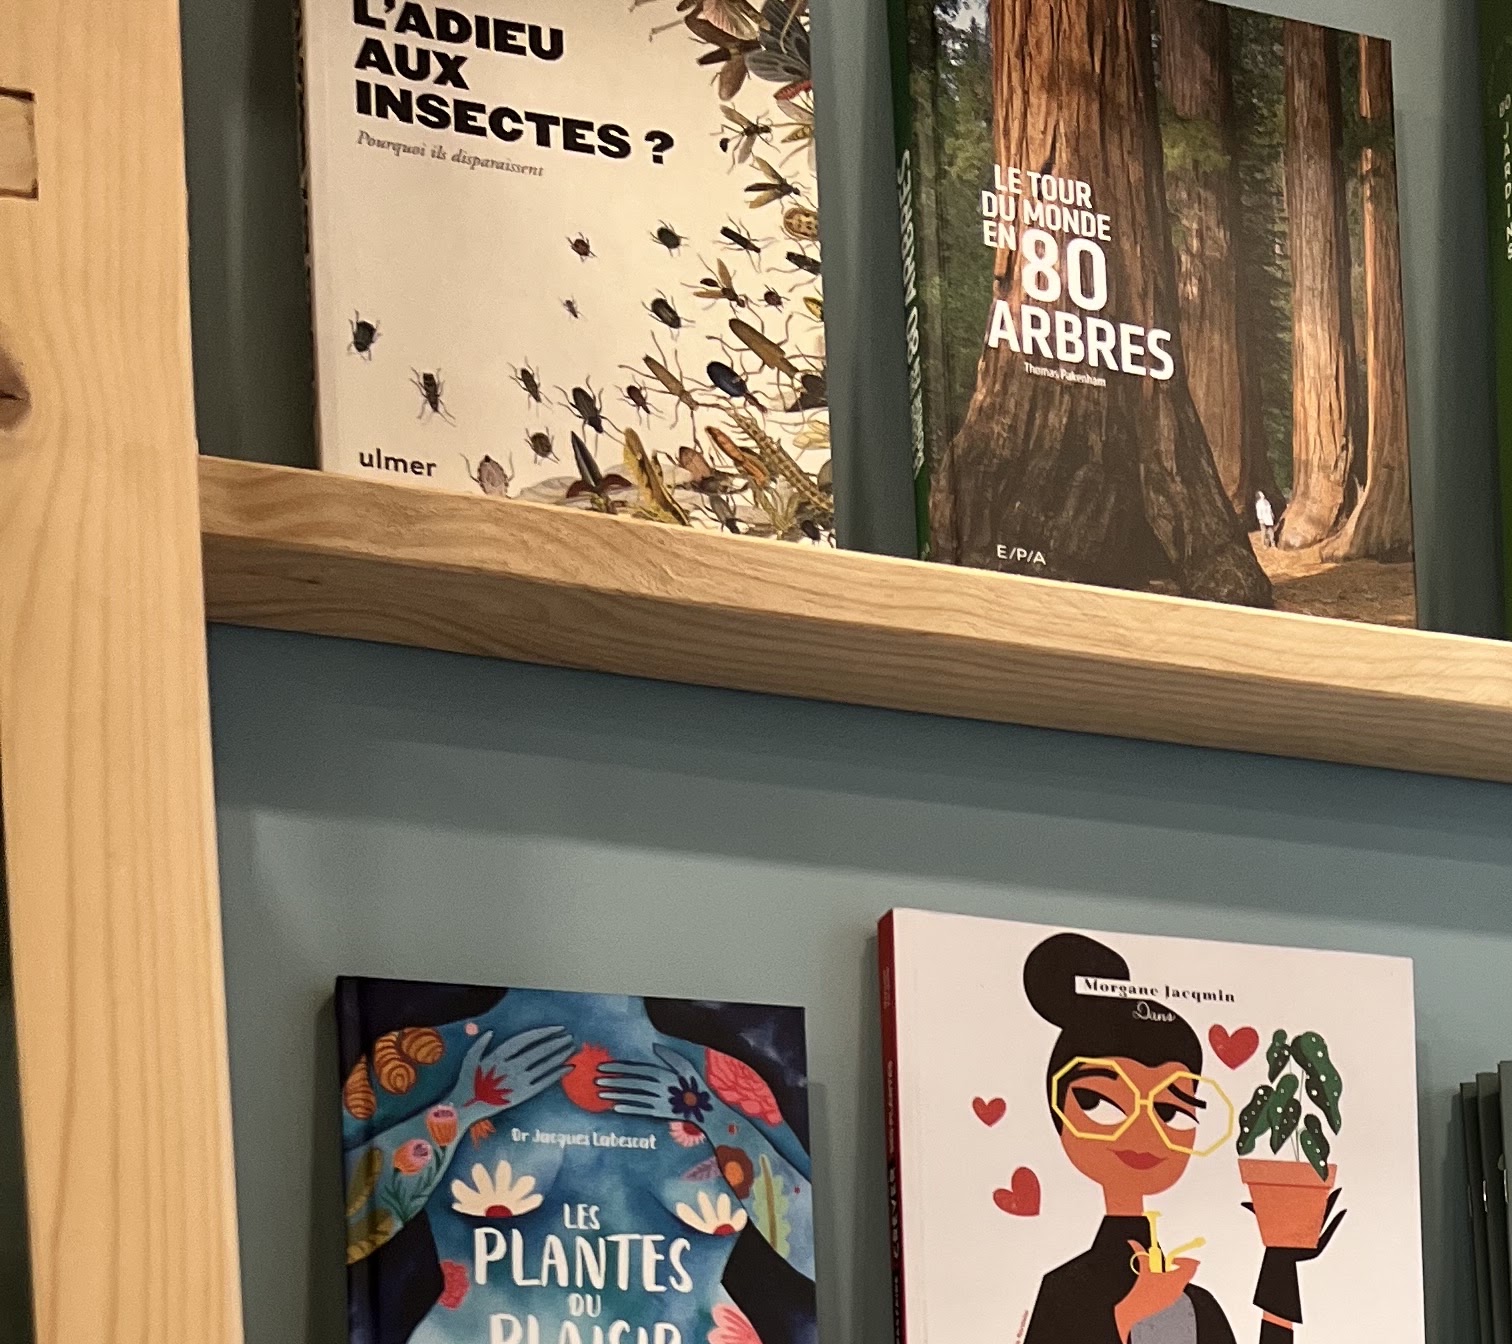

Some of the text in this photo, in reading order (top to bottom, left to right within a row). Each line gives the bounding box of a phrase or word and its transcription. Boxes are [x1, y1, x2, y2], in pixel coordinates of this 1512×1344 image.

[353, 0, 565, 61] L'ADIEU
[354, 37, 470, 90] AUX
[355, 79, 675, 165] INSECTES ?
[356, 129, 545, 178] Pourquoi ils disparaissent
[994, 164, 1093, 209] LE TOUR
[981, 190, 1111, 242] DU MONDE
[983, 220, 1108, 312] EN 80
[987, 299, 1175, 381] ARBRES
[1024, 362, 1059, 380] Thomas
[359, 448, 437, 478] ulmer
[997, 544, 1047, 567] E/P/A
[1084, 978, 1235, 1003] Morgane Jacqmin
[532, 1129, 590, 1150] Jacques
[563, 1203, 599, 1230] LES
[474, 1226, 693, 1293] PLANTES
[568, 1292, 601, 1318] DU
